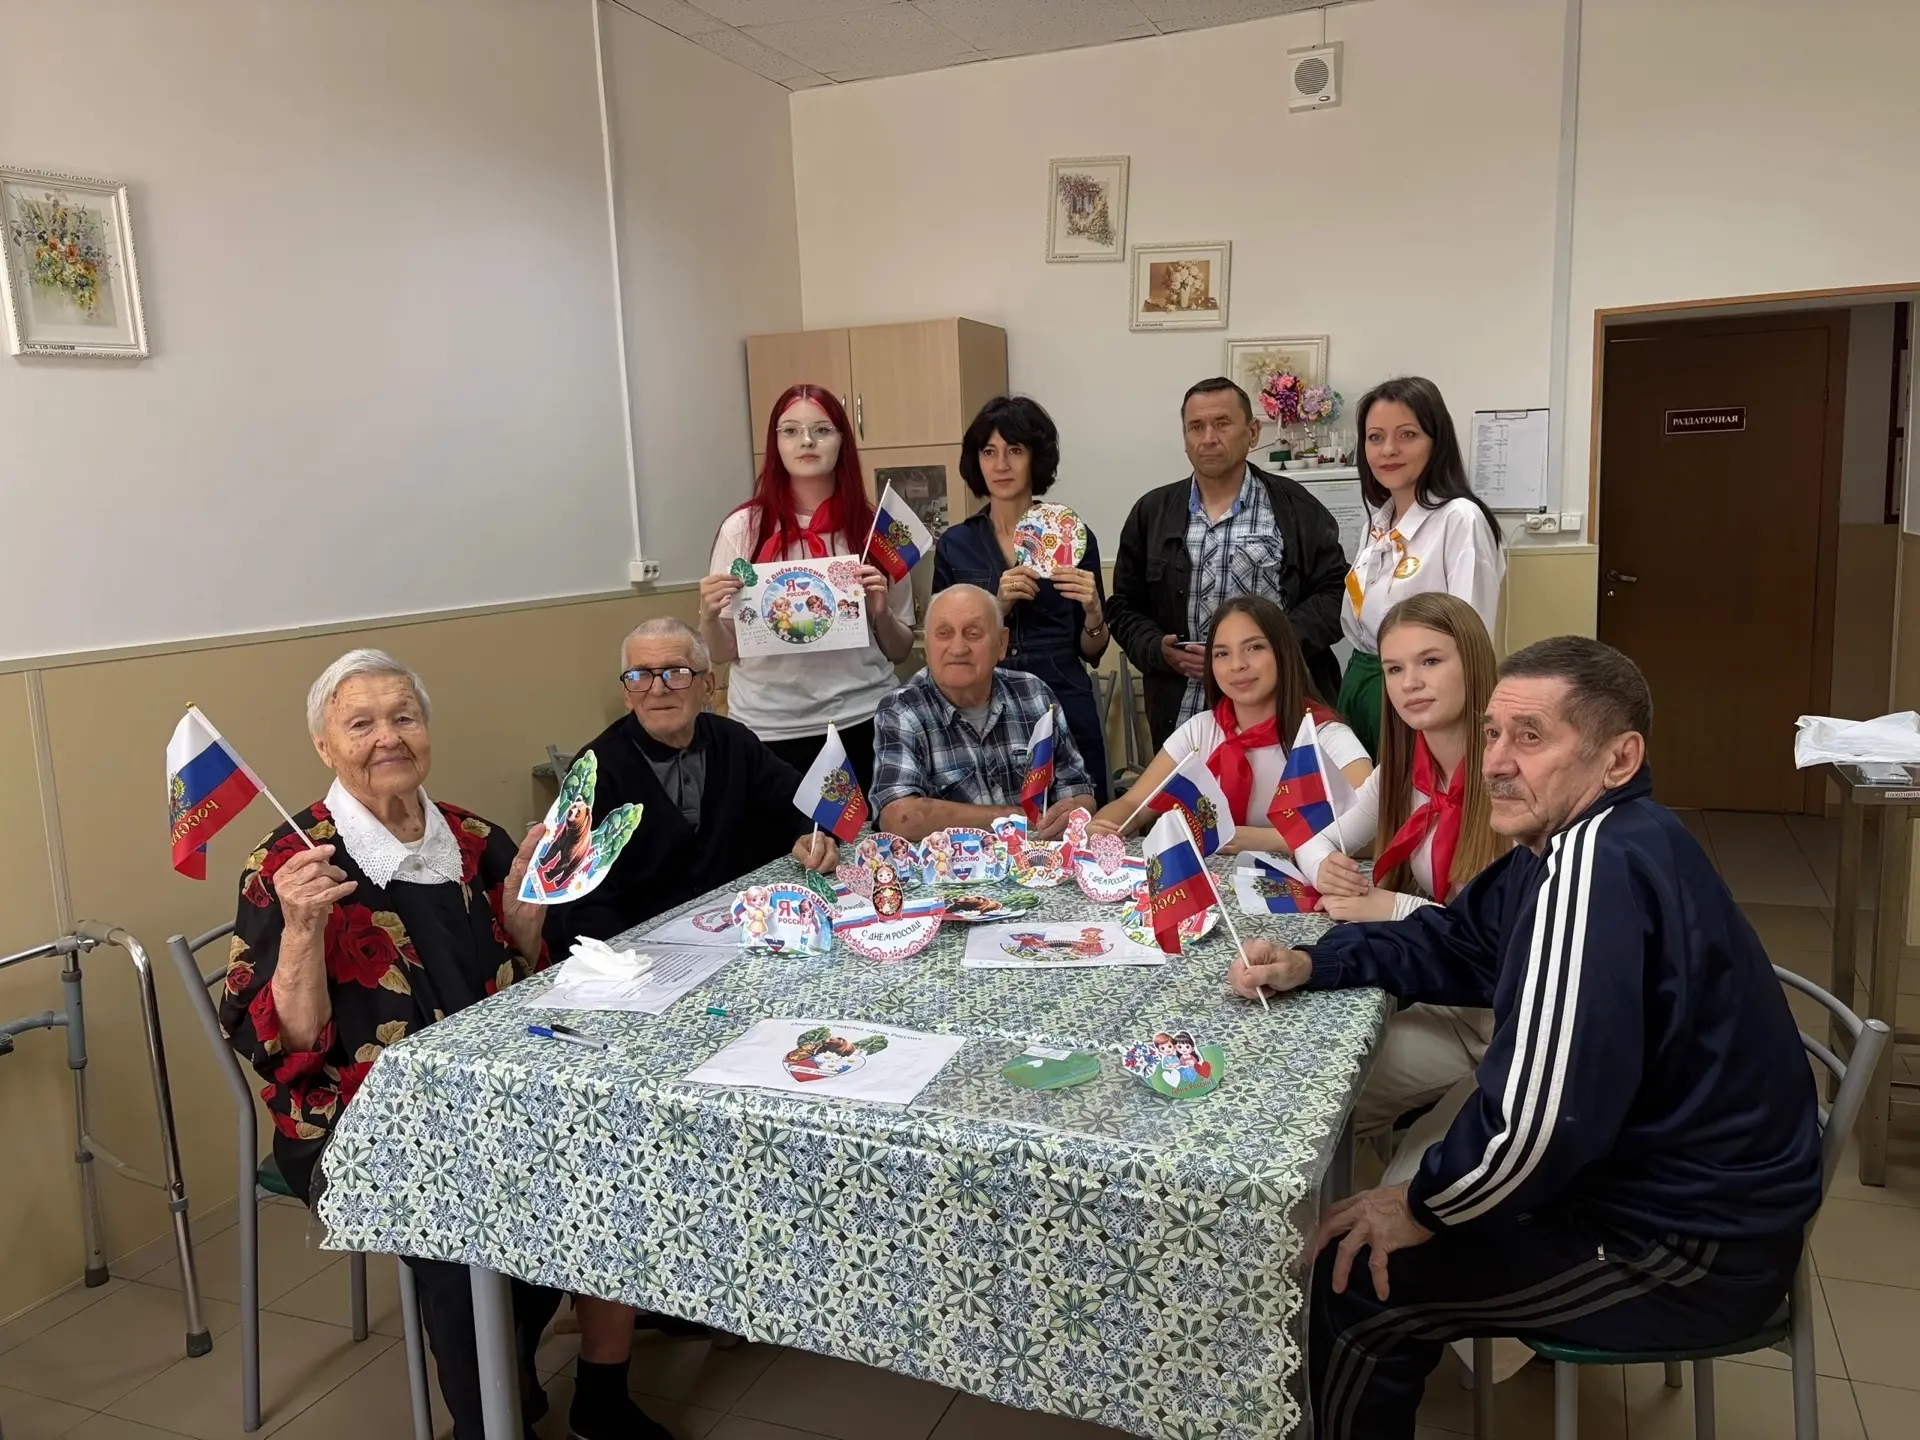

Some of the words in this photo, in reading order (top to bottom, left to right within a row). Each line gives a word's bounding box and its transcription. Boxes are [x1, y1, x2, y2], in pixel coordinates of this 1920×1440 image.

[1672, 415, 1738, 426] РАЗДАТОЧНАЯ
[786, 580, 795, 591] Я
[951, 843, 962, 856] Я
[779, 901, 791, 916] Я
[861, 929, 868, 937] С
[868, 931, 891, 940] ДНЁМ
